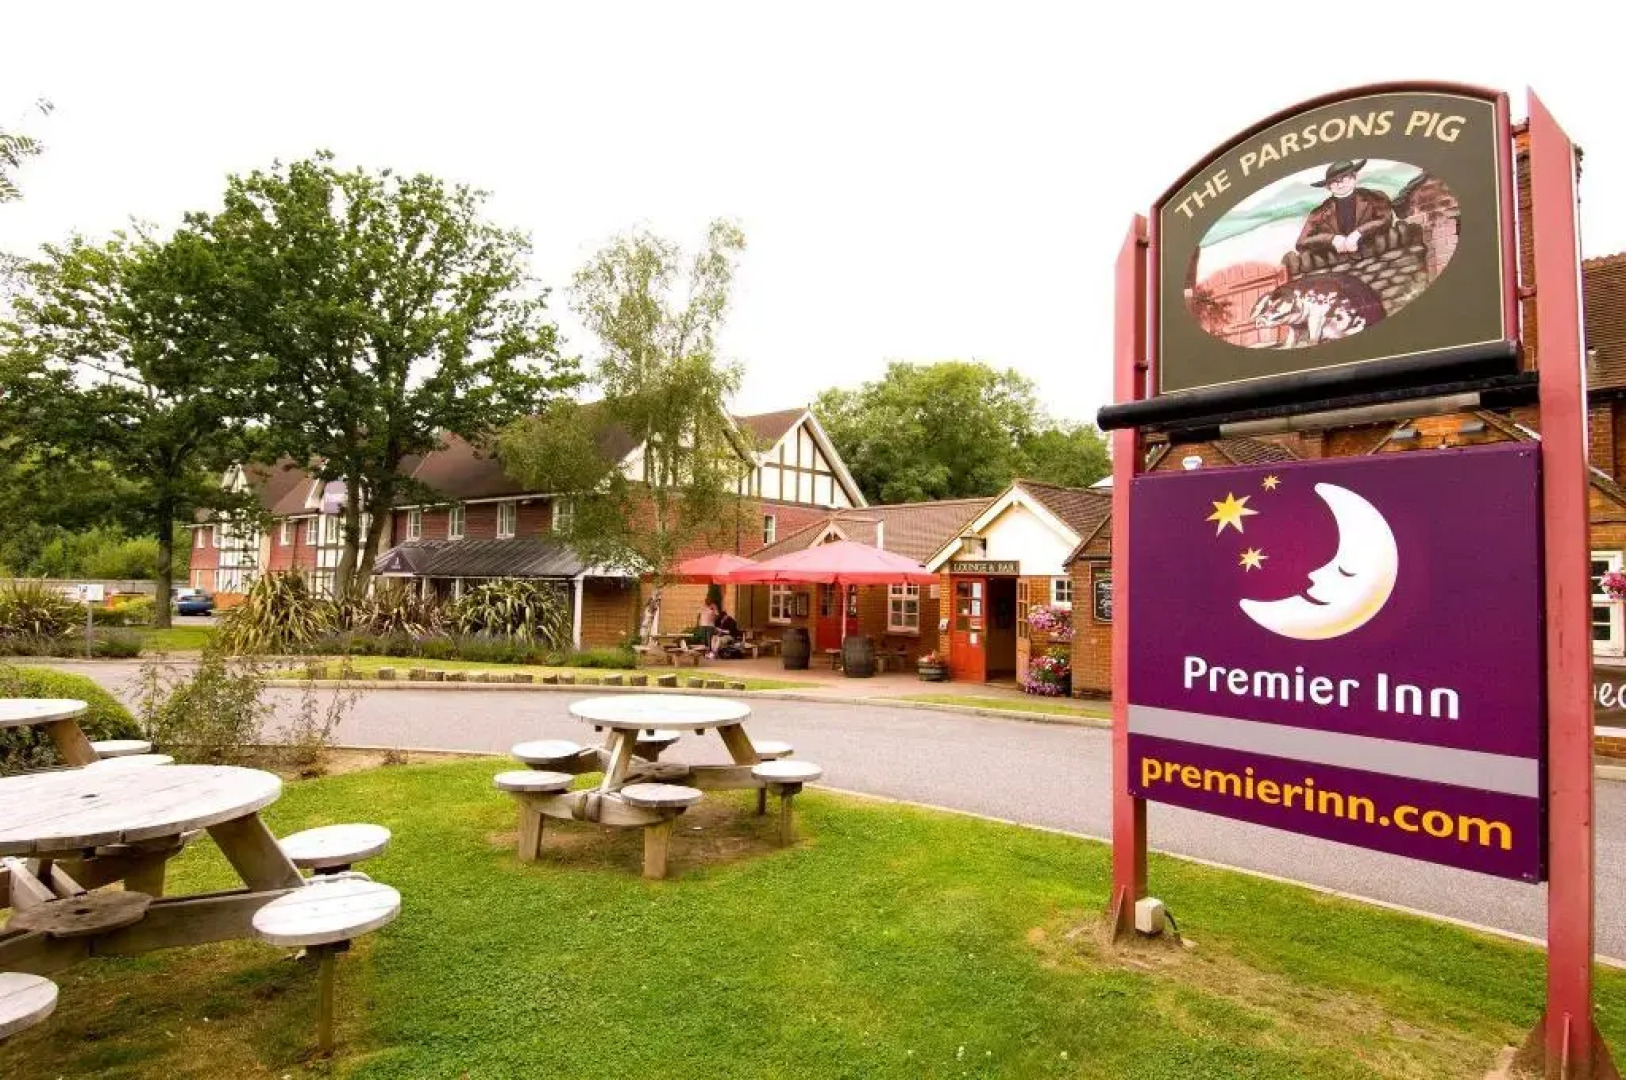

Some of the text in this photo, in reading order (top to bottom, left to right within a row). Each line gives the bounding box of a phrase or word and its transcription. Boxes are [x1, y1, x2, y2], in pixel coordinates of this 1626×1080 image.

[1175, 110, 1466, 219] THE PARSONS PIG
[1184, 656, 1459, 720] Premier Inn
[1141, 756, 1513, 851] premierinn.com
